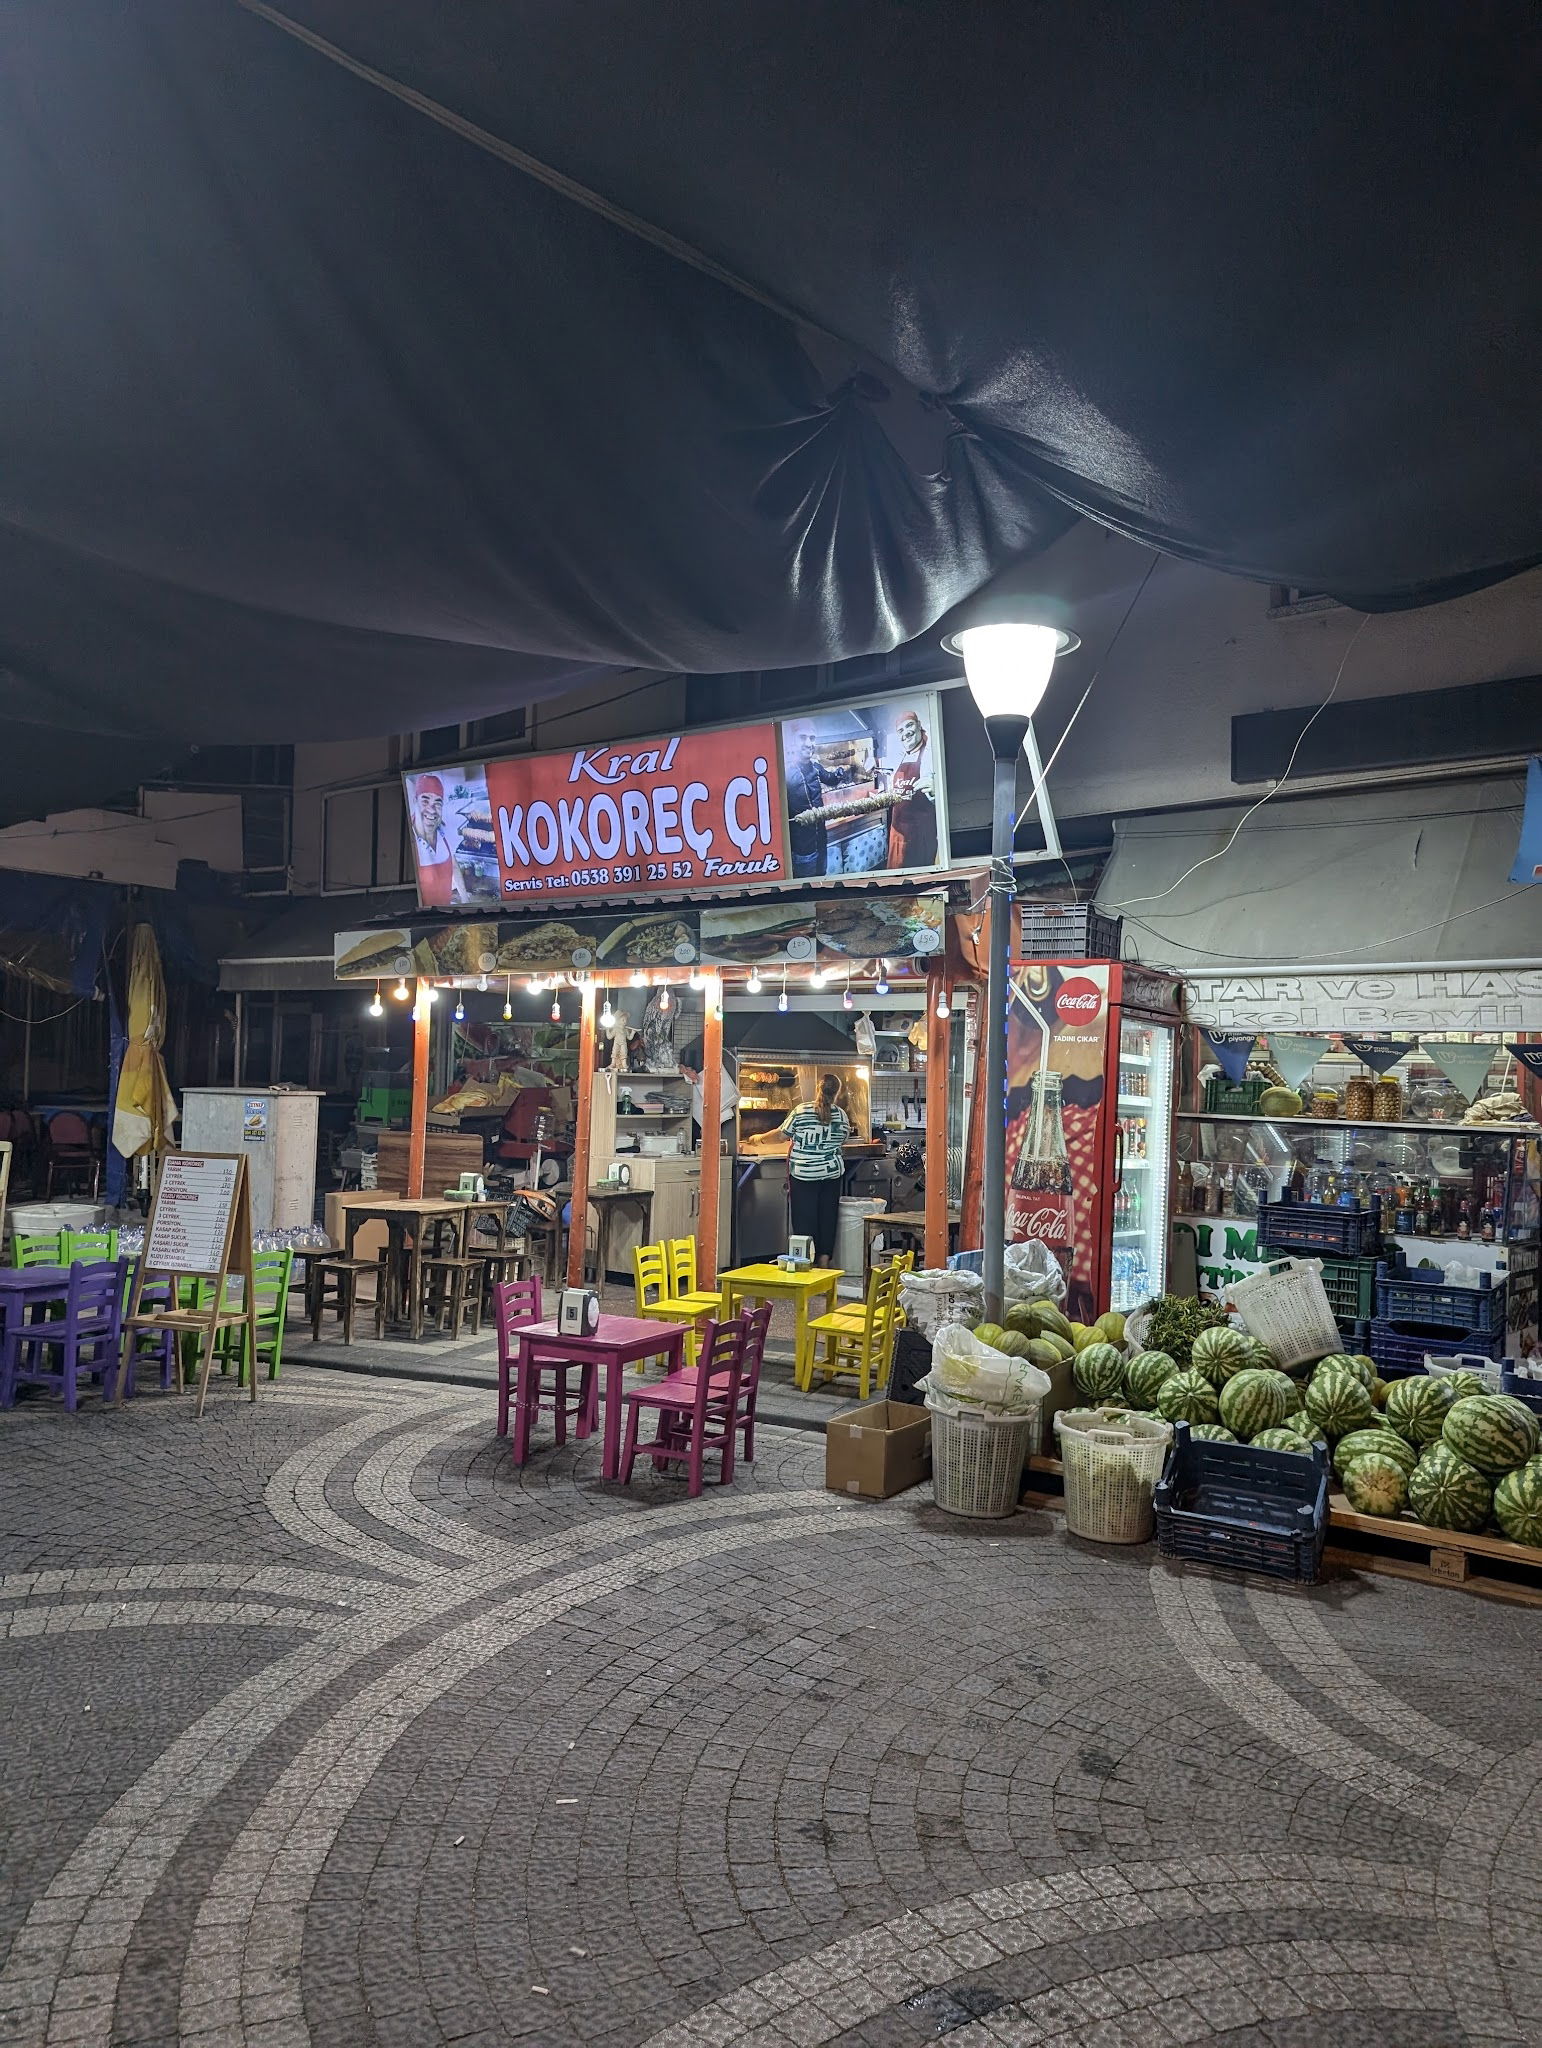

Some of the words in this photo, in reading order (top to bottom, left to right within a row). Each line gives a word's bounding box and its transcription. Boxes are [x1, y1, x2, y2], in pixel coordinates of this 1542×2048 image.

[568, 737, 681, 785] Kral
[498, 781, 713, 868] KOKOREÇ
[505, 876, 543, 892] Servis
[546, 875, 570, 889] Tel:
[571, 868, 609, 886] 0538
[613, 865, 641, 883] 391
[647, 864, 667, 881] 25
[672, 861, 692, 879] 52
[703, 853, 780, 877] Faruk
[1186, 977, 1304, 1002] TAR
[1317, 979, 1396, 1001] ve
[1076, 1035, 1099, 1043] ÇIKAR
[1229, 1035, 1256, 1043] piyango
[1006, 1203, 1068, 1240] oca-Cola
